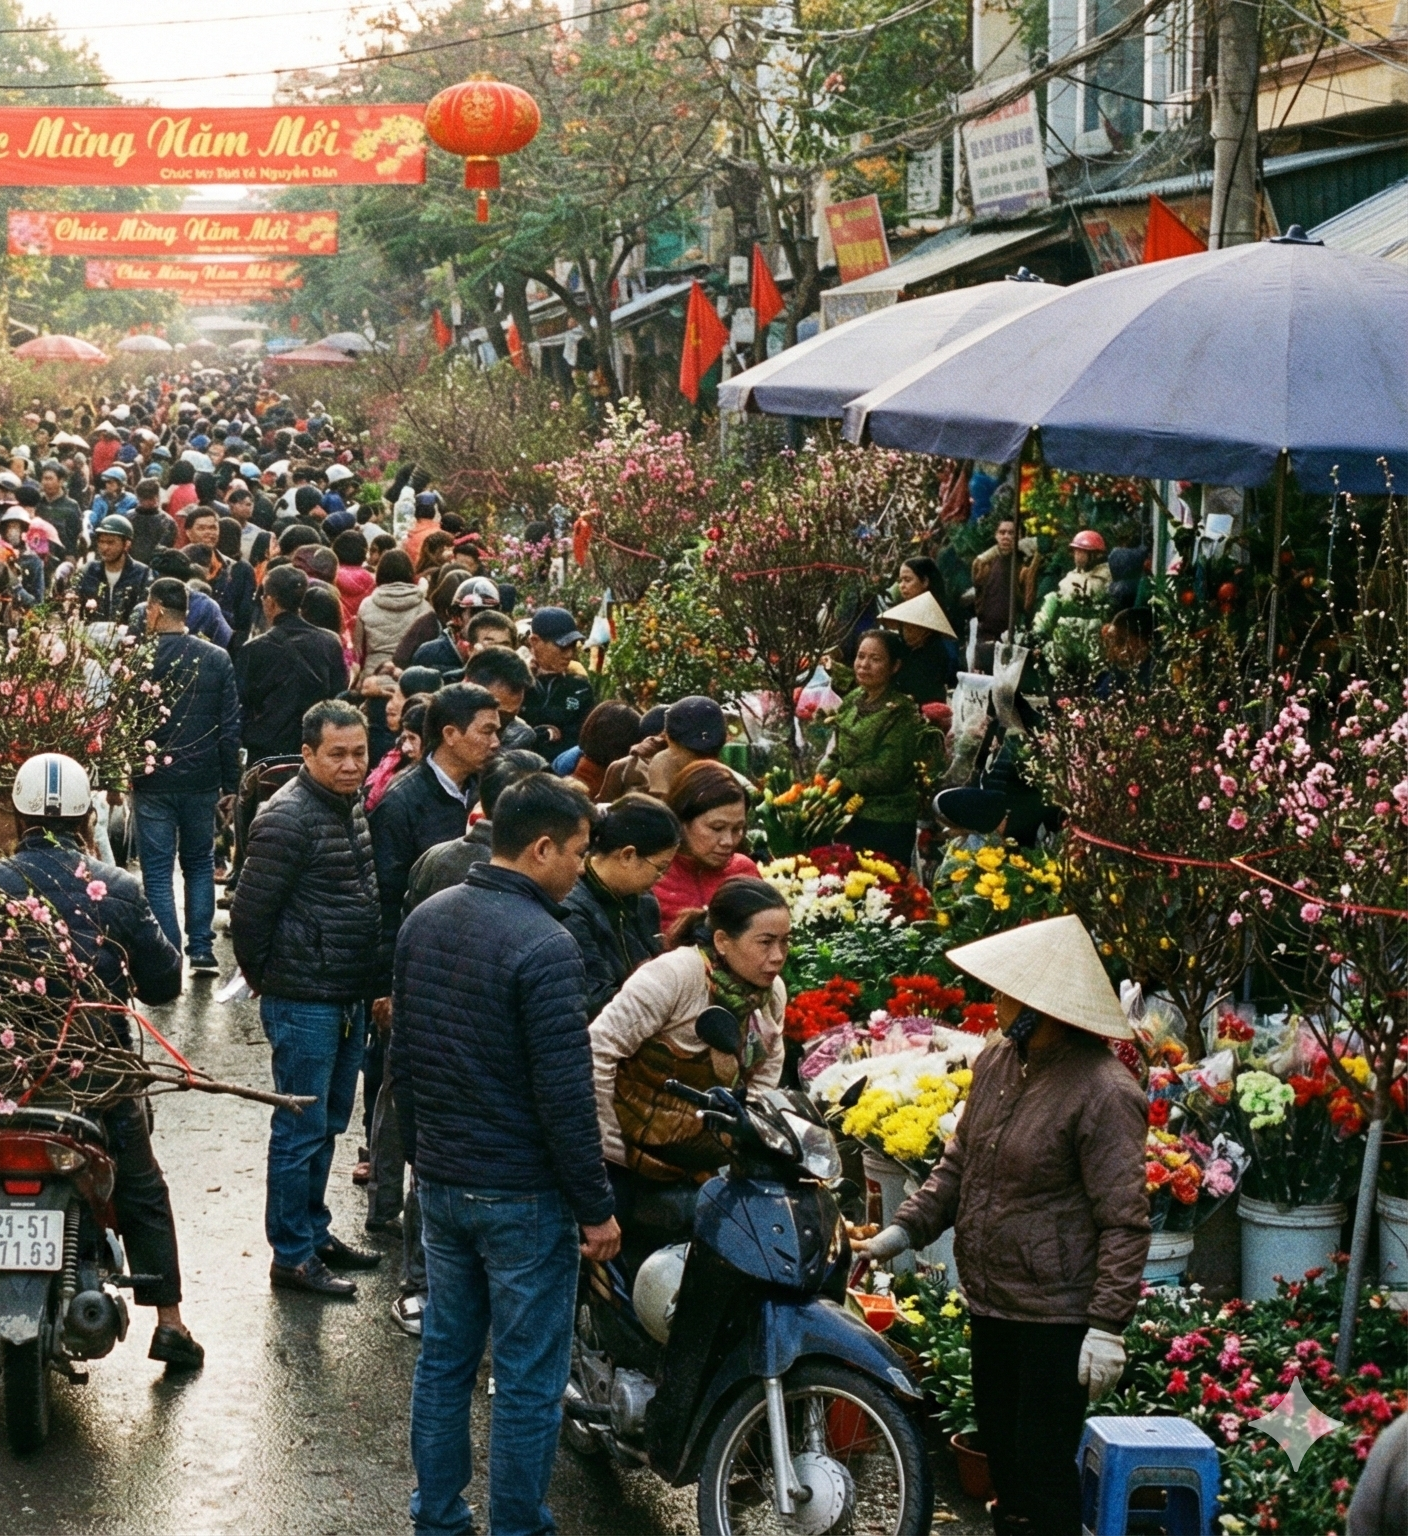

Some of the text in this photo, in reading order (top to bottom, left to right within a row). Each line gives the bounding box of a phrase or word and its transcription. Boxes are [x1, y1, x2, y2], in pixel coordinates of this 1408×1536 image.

[17, 116, 137, 168] Mừng
[147, 116, 252, 159] Năm
[257, 115, 341, 157] Mới
[55, 217, 291, 247] Chúc Mừng Năm Mới
